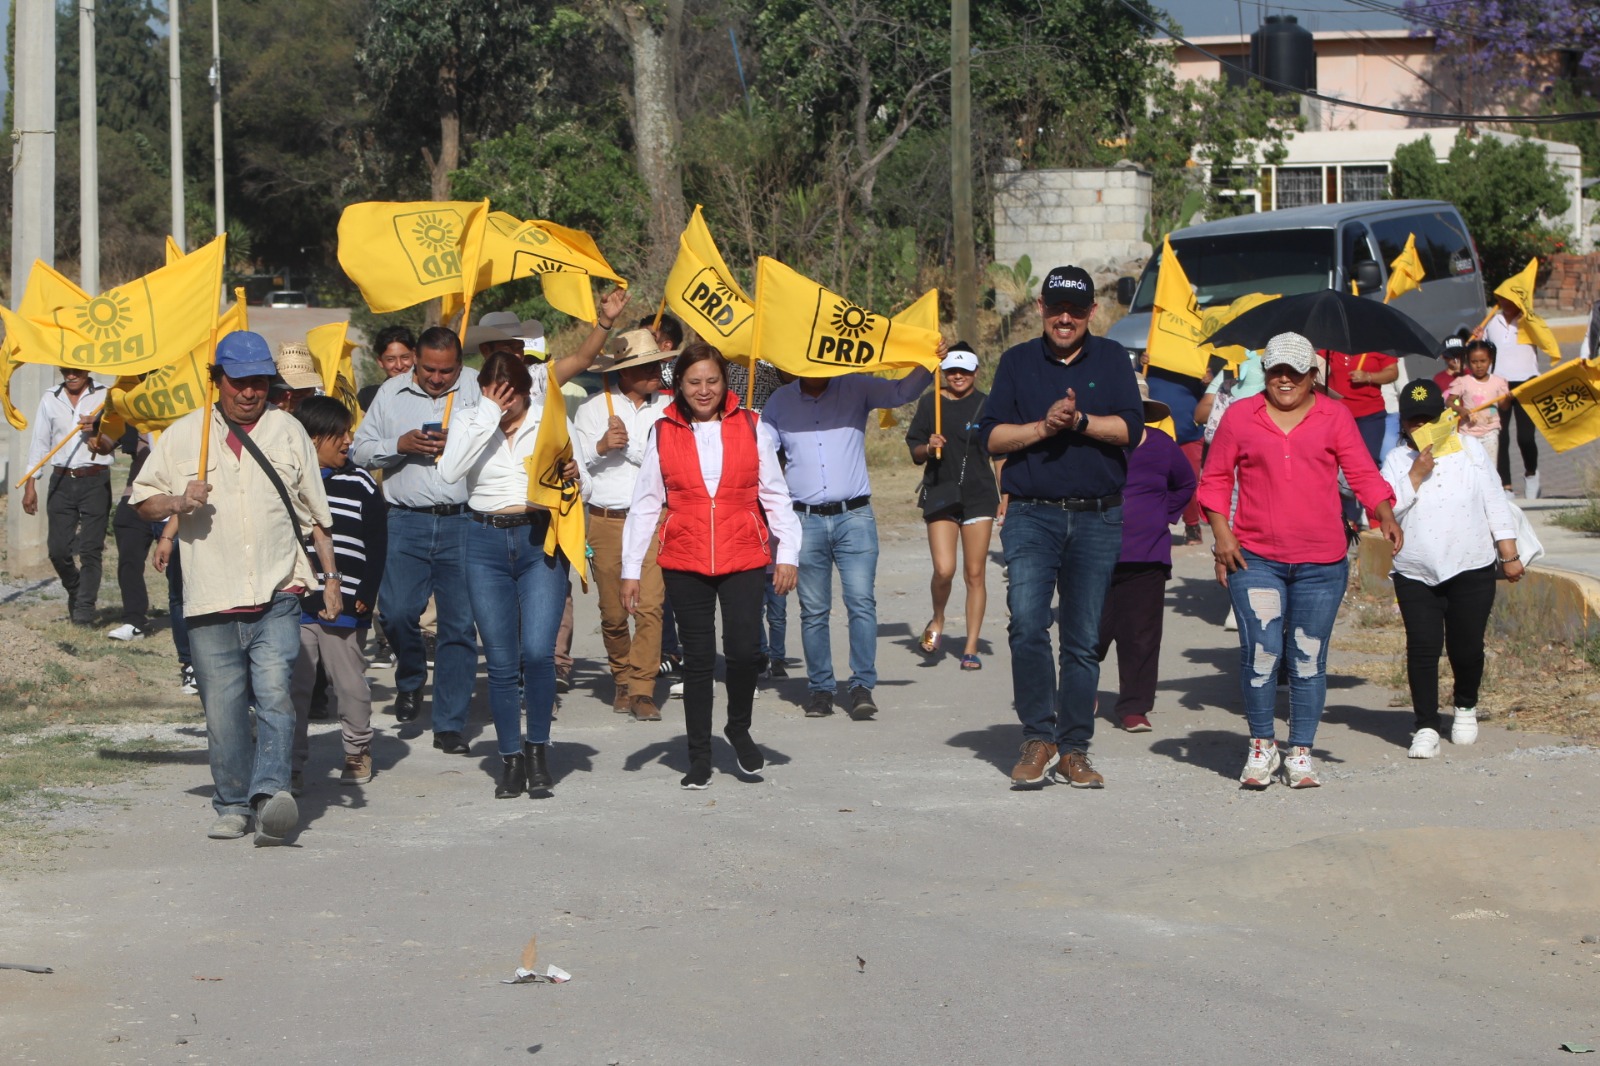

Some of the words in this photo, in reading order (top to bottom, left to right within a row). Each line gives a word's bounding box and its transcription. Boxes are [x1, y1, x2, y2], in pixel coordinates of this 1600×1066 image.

[1048, 279, 1087, 291] CAMBRÓN
[689, 281, 734, 326] PRD
[816, 335, 875, 364] PRD
[1536, 394, 1563, 424] PRD
